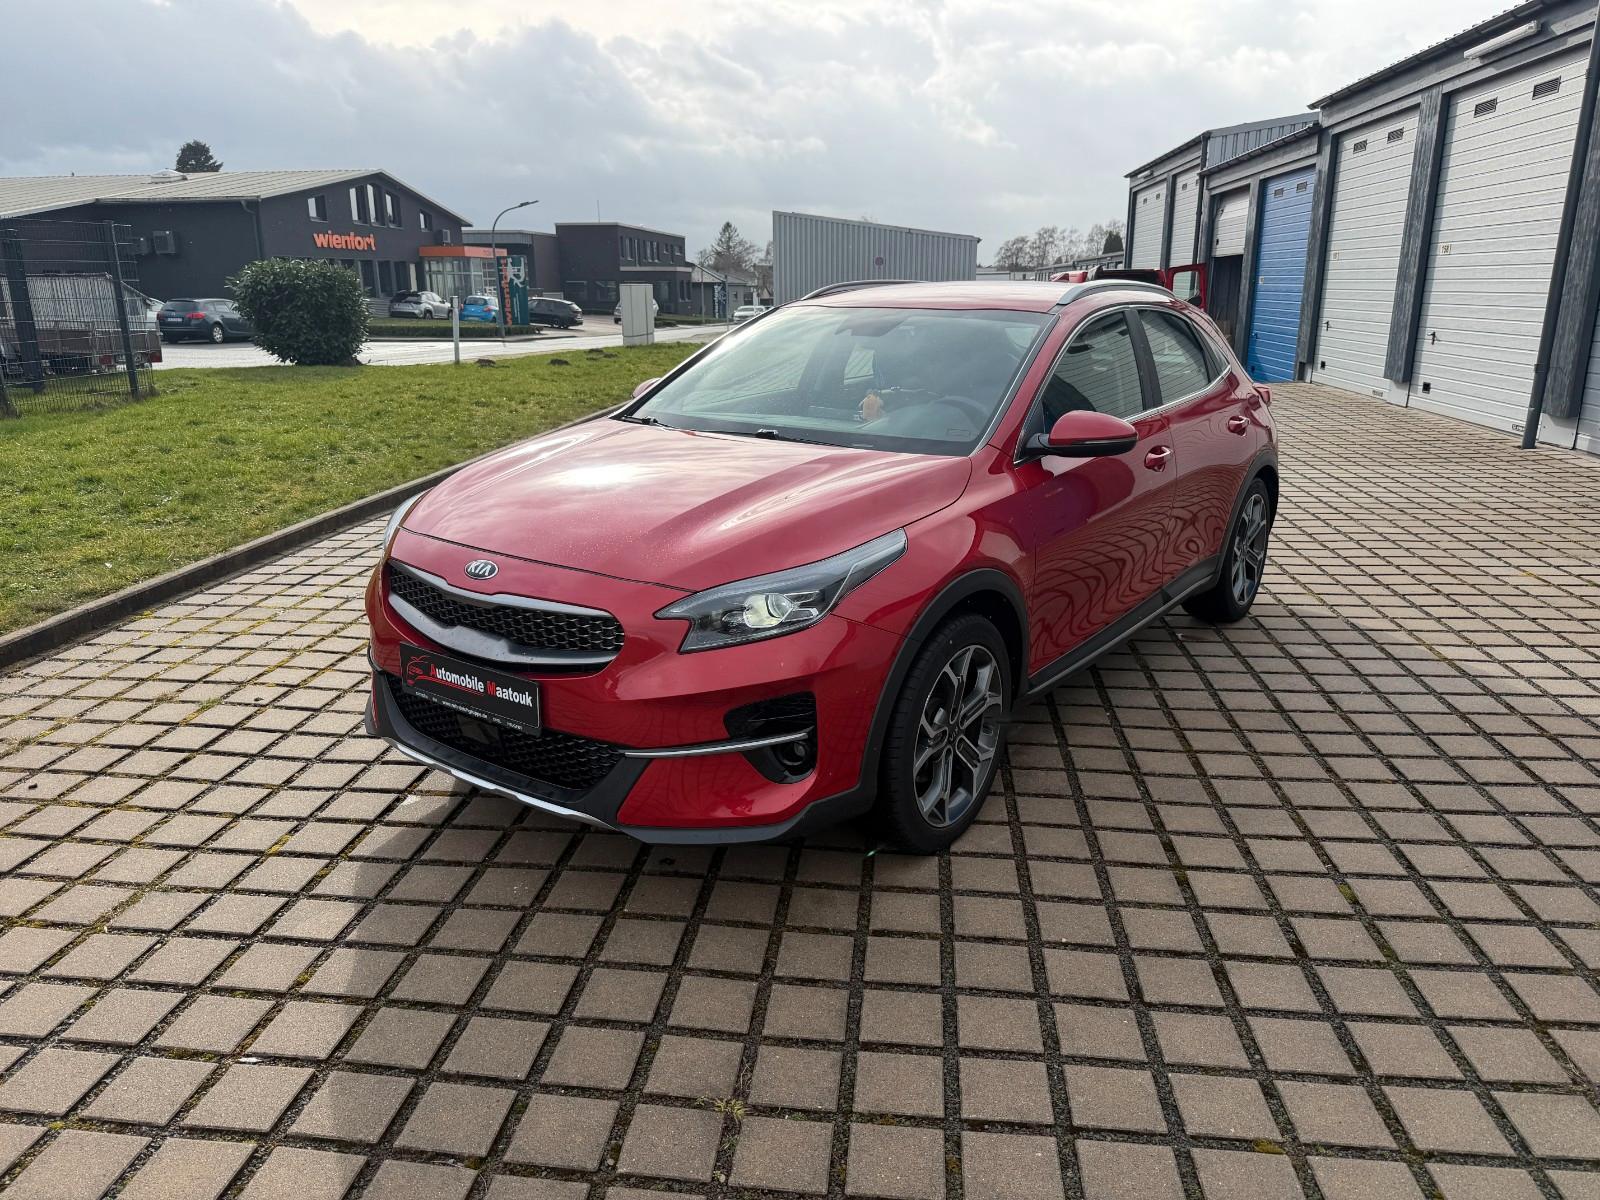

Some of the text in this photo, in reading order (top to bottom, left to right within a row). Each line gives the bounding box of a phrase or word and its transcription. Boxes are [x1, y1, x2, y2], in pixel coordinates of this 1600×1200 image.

[313, 231, 376, 251] wienfort
[467, 561, 492, 576] KIA
[430, 664, 533, 707] Automobile Maatouk
